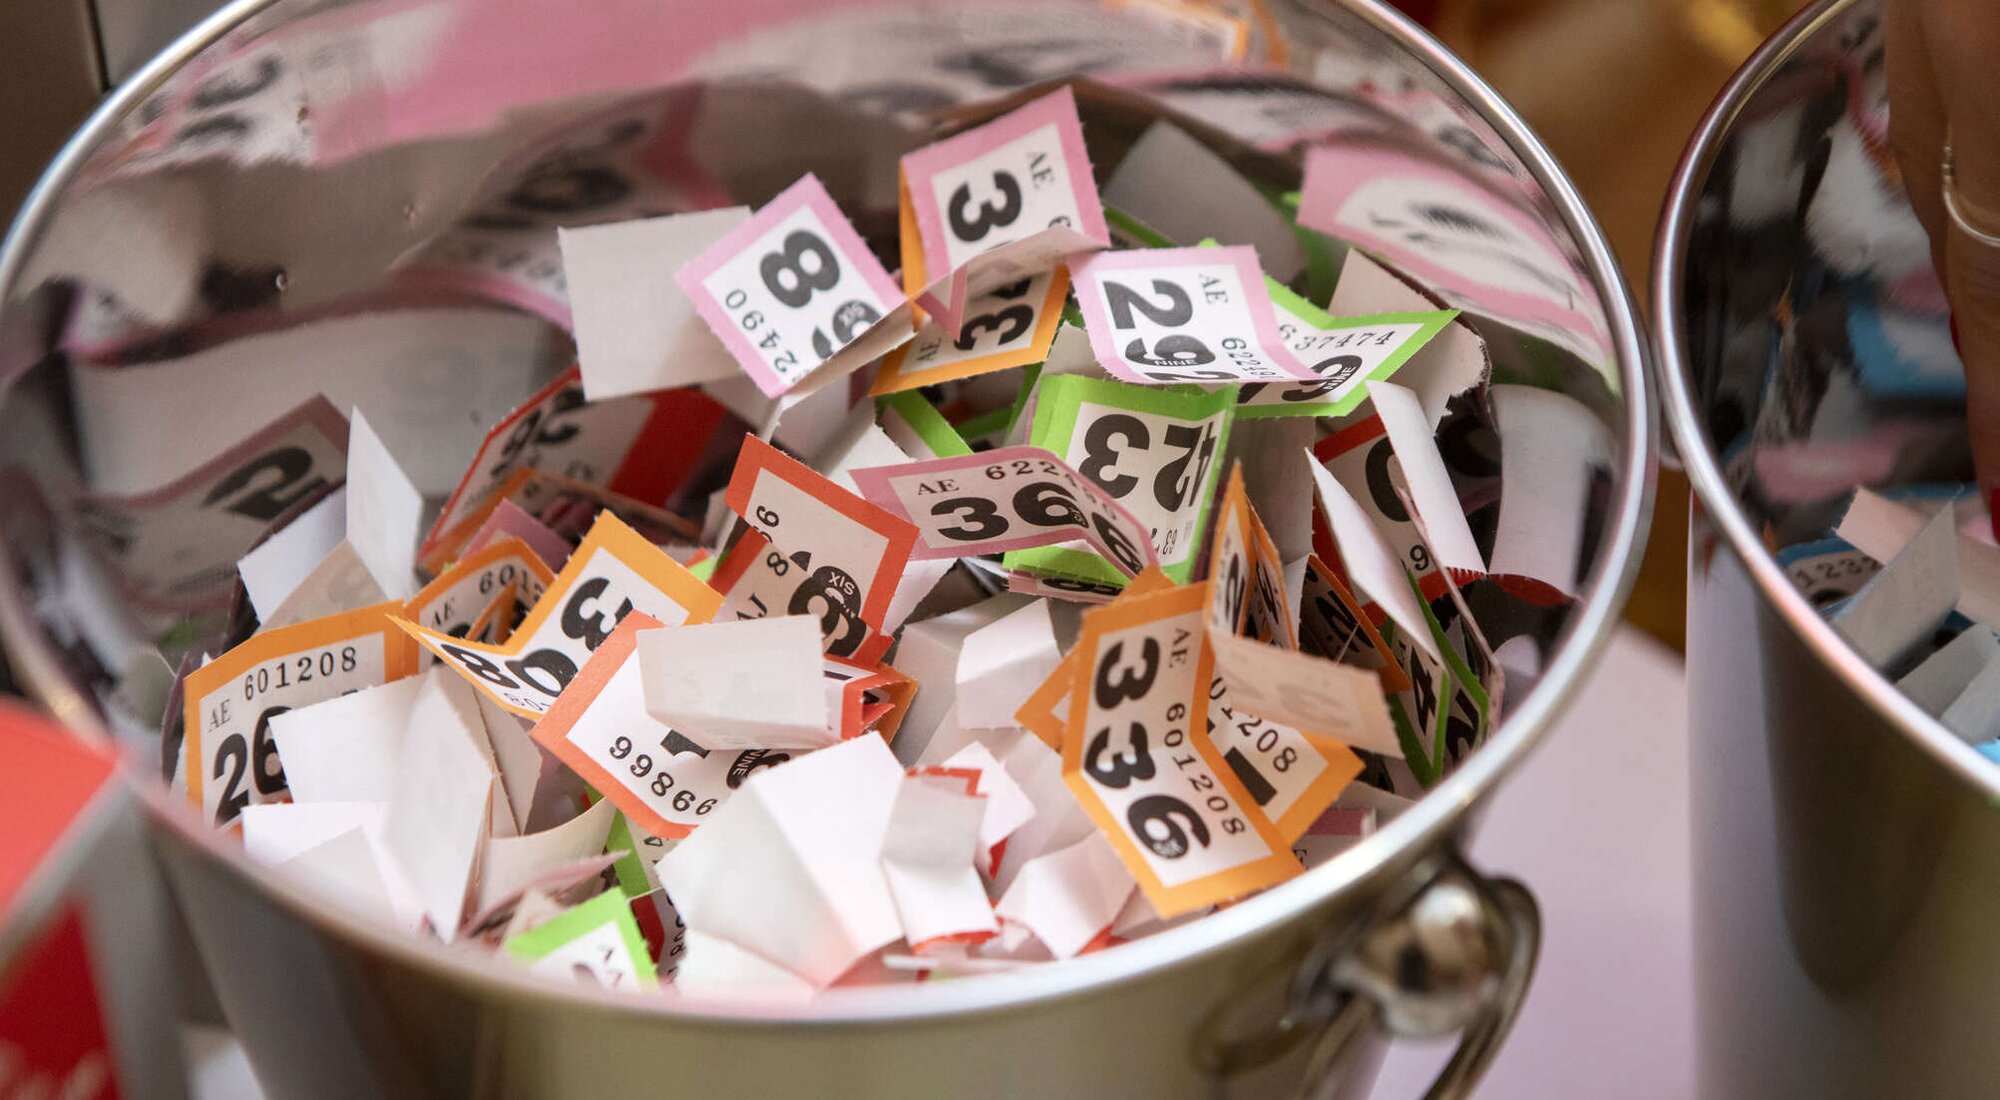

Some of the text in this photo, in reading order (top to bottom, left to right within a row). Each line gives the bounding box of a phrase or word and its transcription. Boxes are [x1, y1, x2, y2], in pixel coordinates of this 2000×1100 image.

[1028, 151, 1055, 189] AE
[1199, 272, 1228, 305] AE
[725, 288, 804, 382] 2490
[1153, 357, 1199, 367] NINE
[916, 478, 961, 497] AE
[828, 571, 856, 597] SIX
[1168, 627, 1191, 669] AE
[244, 646, 357, 701] 601208
[208, 698, 232, 733] AE
[1085, 636, 1212, 859] 336
[1164, 702, 1246, 836] 601208
